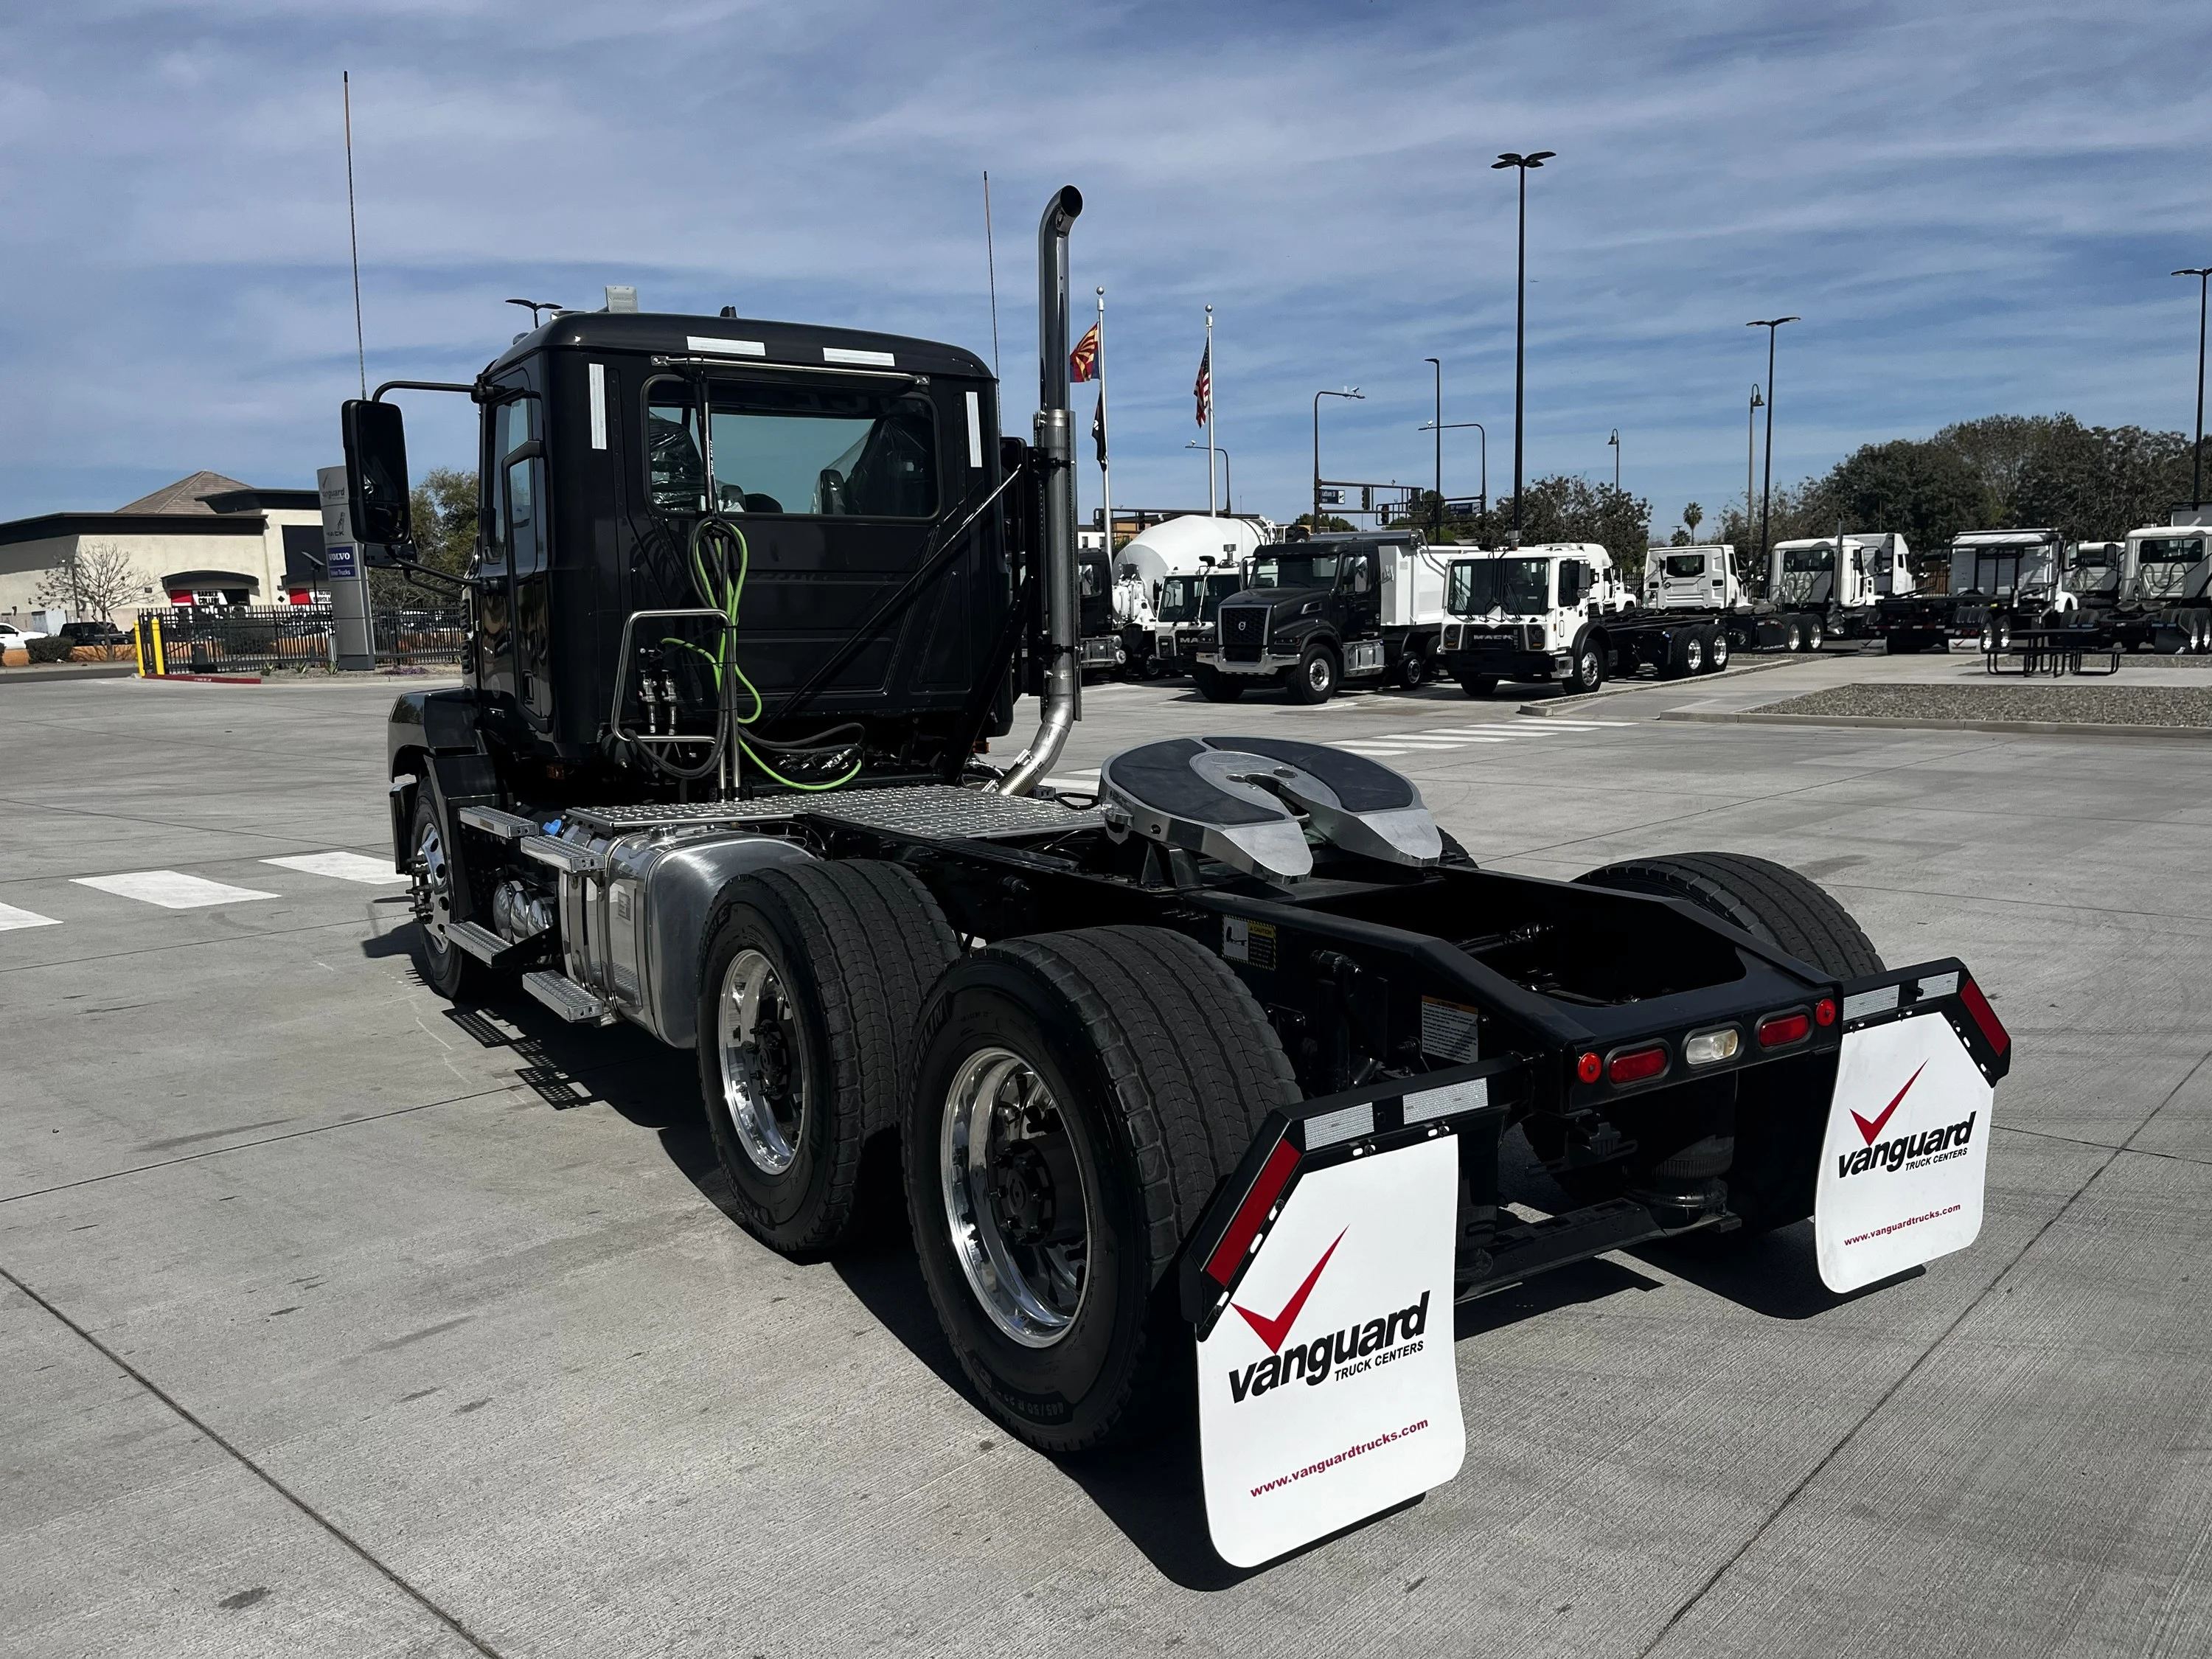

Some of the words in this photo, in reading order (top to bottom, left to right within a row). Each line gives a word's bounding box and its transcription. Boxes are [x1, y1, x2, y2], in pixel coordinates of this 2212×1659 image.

[328, 552, 350, 561] VOLVO
[1253, 926, 1272, 935] CAUTION
[906, 998, 945, 1133] MICHELIN
[1840, 1111, 1977, 1179] vanguard
[1905, 1158, 1931, 1171] TRUCK
[1933, 1148, 1968, 1163] CENTERS
[1844, 1204, 1961, 1245] www.vanguardtrucks.com
[1229, 1290, 1430, 1404] vanguard
[1335, 1359, 1372, 1382] TRUCK
[1374, 1340, 1424, 1366] CENTERS
[1250, 1419, 1428, 1498] www.vanguardtrucks.com
